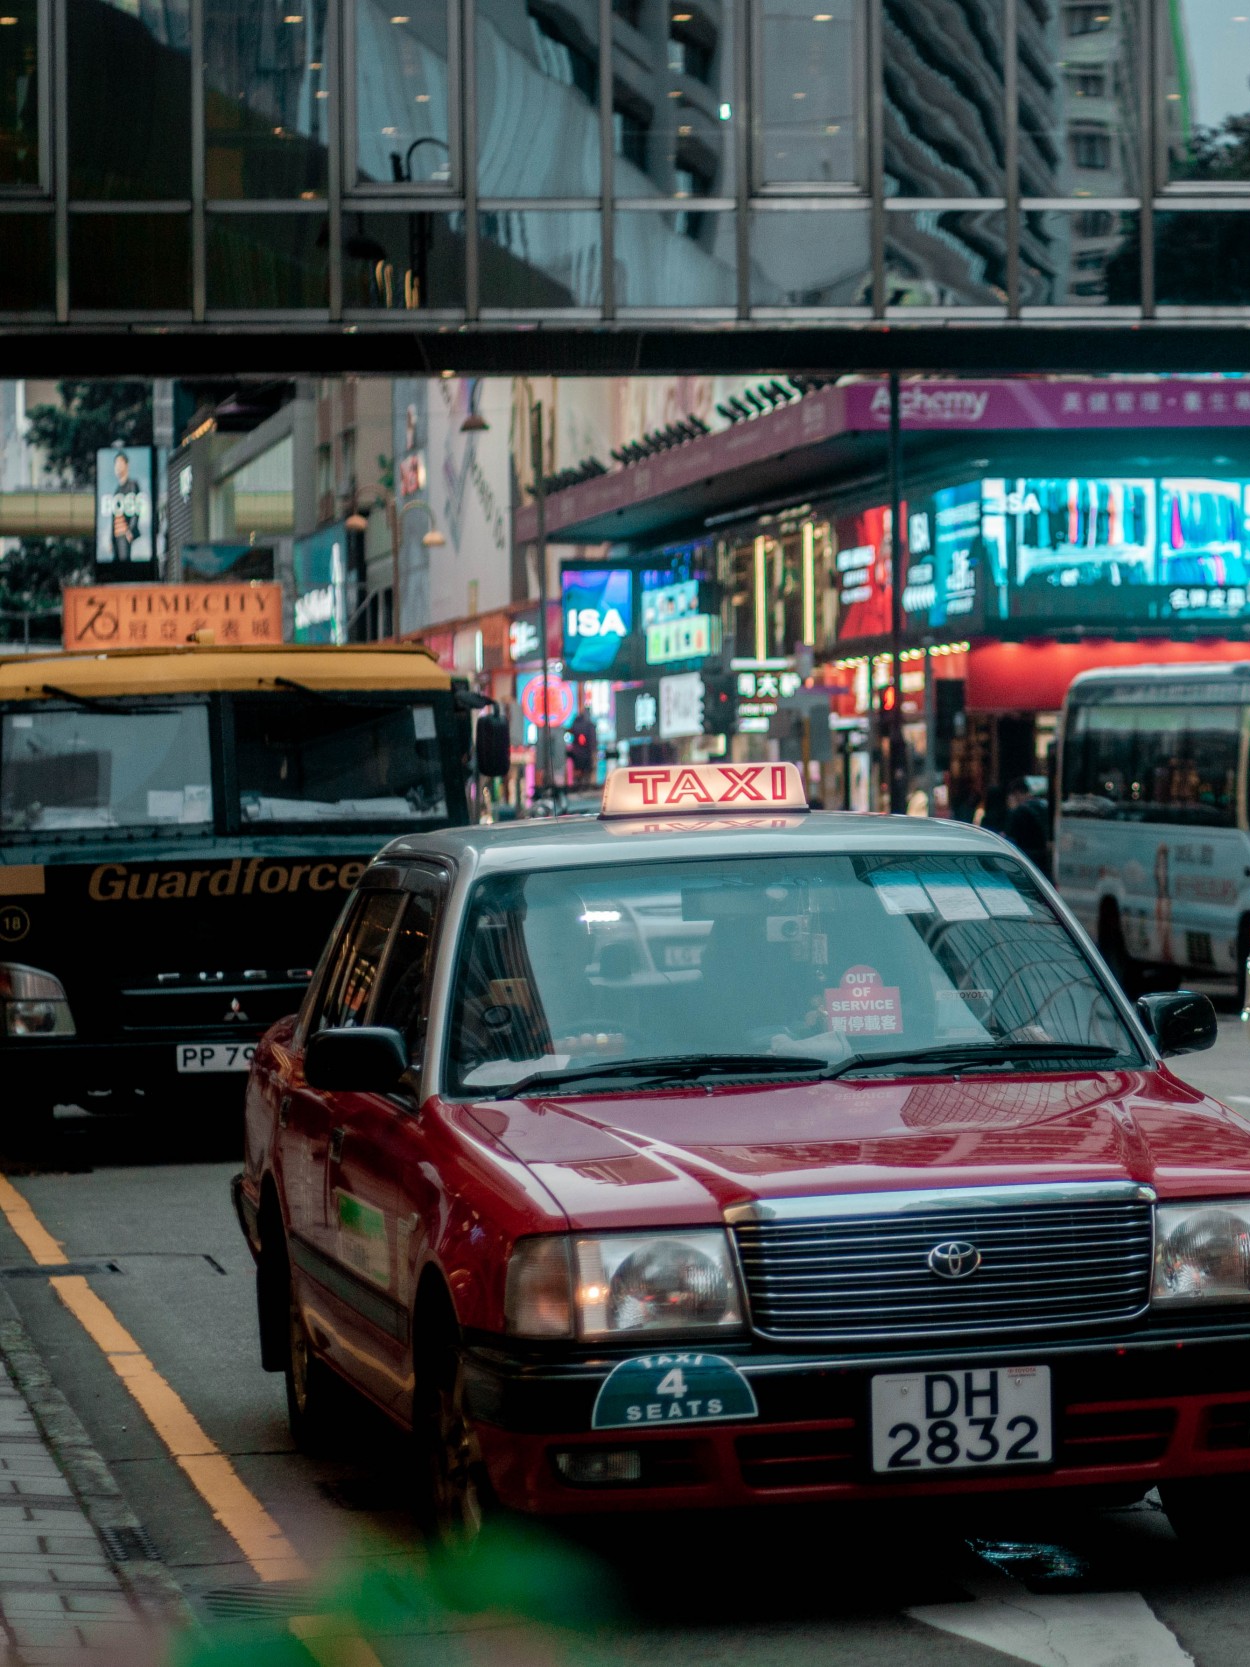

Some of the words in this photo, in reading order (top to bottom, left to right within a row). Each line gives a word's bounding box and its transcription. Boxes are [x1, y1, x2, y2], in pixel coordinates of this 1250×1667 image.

[870, 385, 990, 421] Achemy
[127, 592, 271, 614] TIMECITY
[567, 608, 627, 637] ISA
[628, 765, 787, 805] TAXI
[89, 857, 367, 901] Guardforce
[3, 916, 21, 931] 18
[845, 972, 876, 984] OUT
[852, 986, 871, 998] OF
[831, 999, 894, 1012] SERVICE
[831, 1015, 897, 1032] 暫停載客
[182, 1047, 215, 1068] PP
[636, 1353, 704, 1369] TAXI
[656, 1367, 688, 1399] 4
[924, 1371, 999, 1419] DH
[625, 1398, 724, 1422] SEATS
[886, 1414, 1040, 1469] 2832
